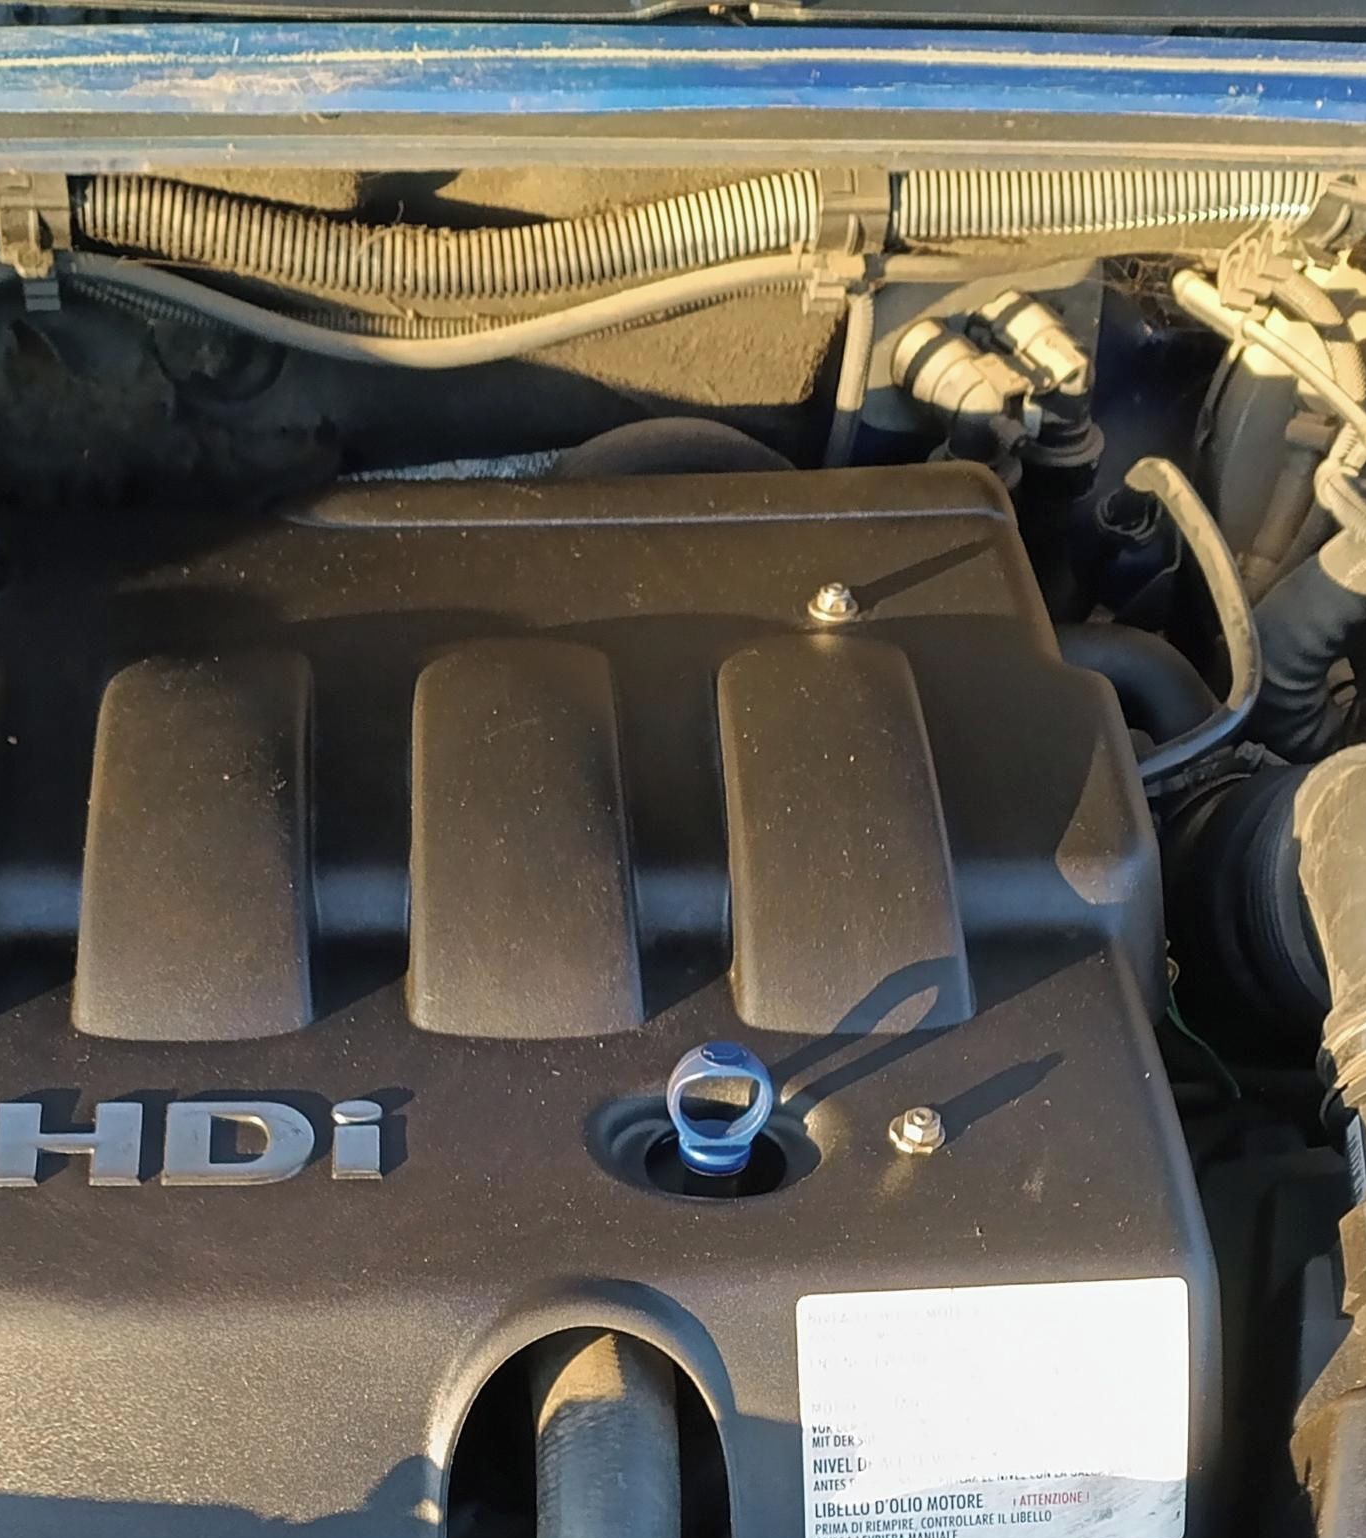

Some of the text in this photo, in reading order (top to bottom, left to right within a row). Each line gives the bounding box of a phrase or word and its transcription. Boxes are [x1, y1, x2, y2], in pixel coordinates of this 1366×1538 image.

[812, 1435, 830, 1449] MIT
[833, 1434, 855, 1448] DER
[813, 1457, 853, 1475] NIVEL
[813, 1479, 847, 1492] ANTES
[875, 1496, 923, 1515] D'OLIO
[927, 1493, 984, 1512] MOTORE
[1019, 1491, 1083, 1506] ATTENZIONE
[815, 1521, 848, 1535] PRIMA
[851, 1520, 863, 1534] DI
[921, 1513, 994, 1530] CONTROLLARE
[998, 1513, 1007, 1525] IL
[1010, 1510, 1052, 1524] LIBELLO
